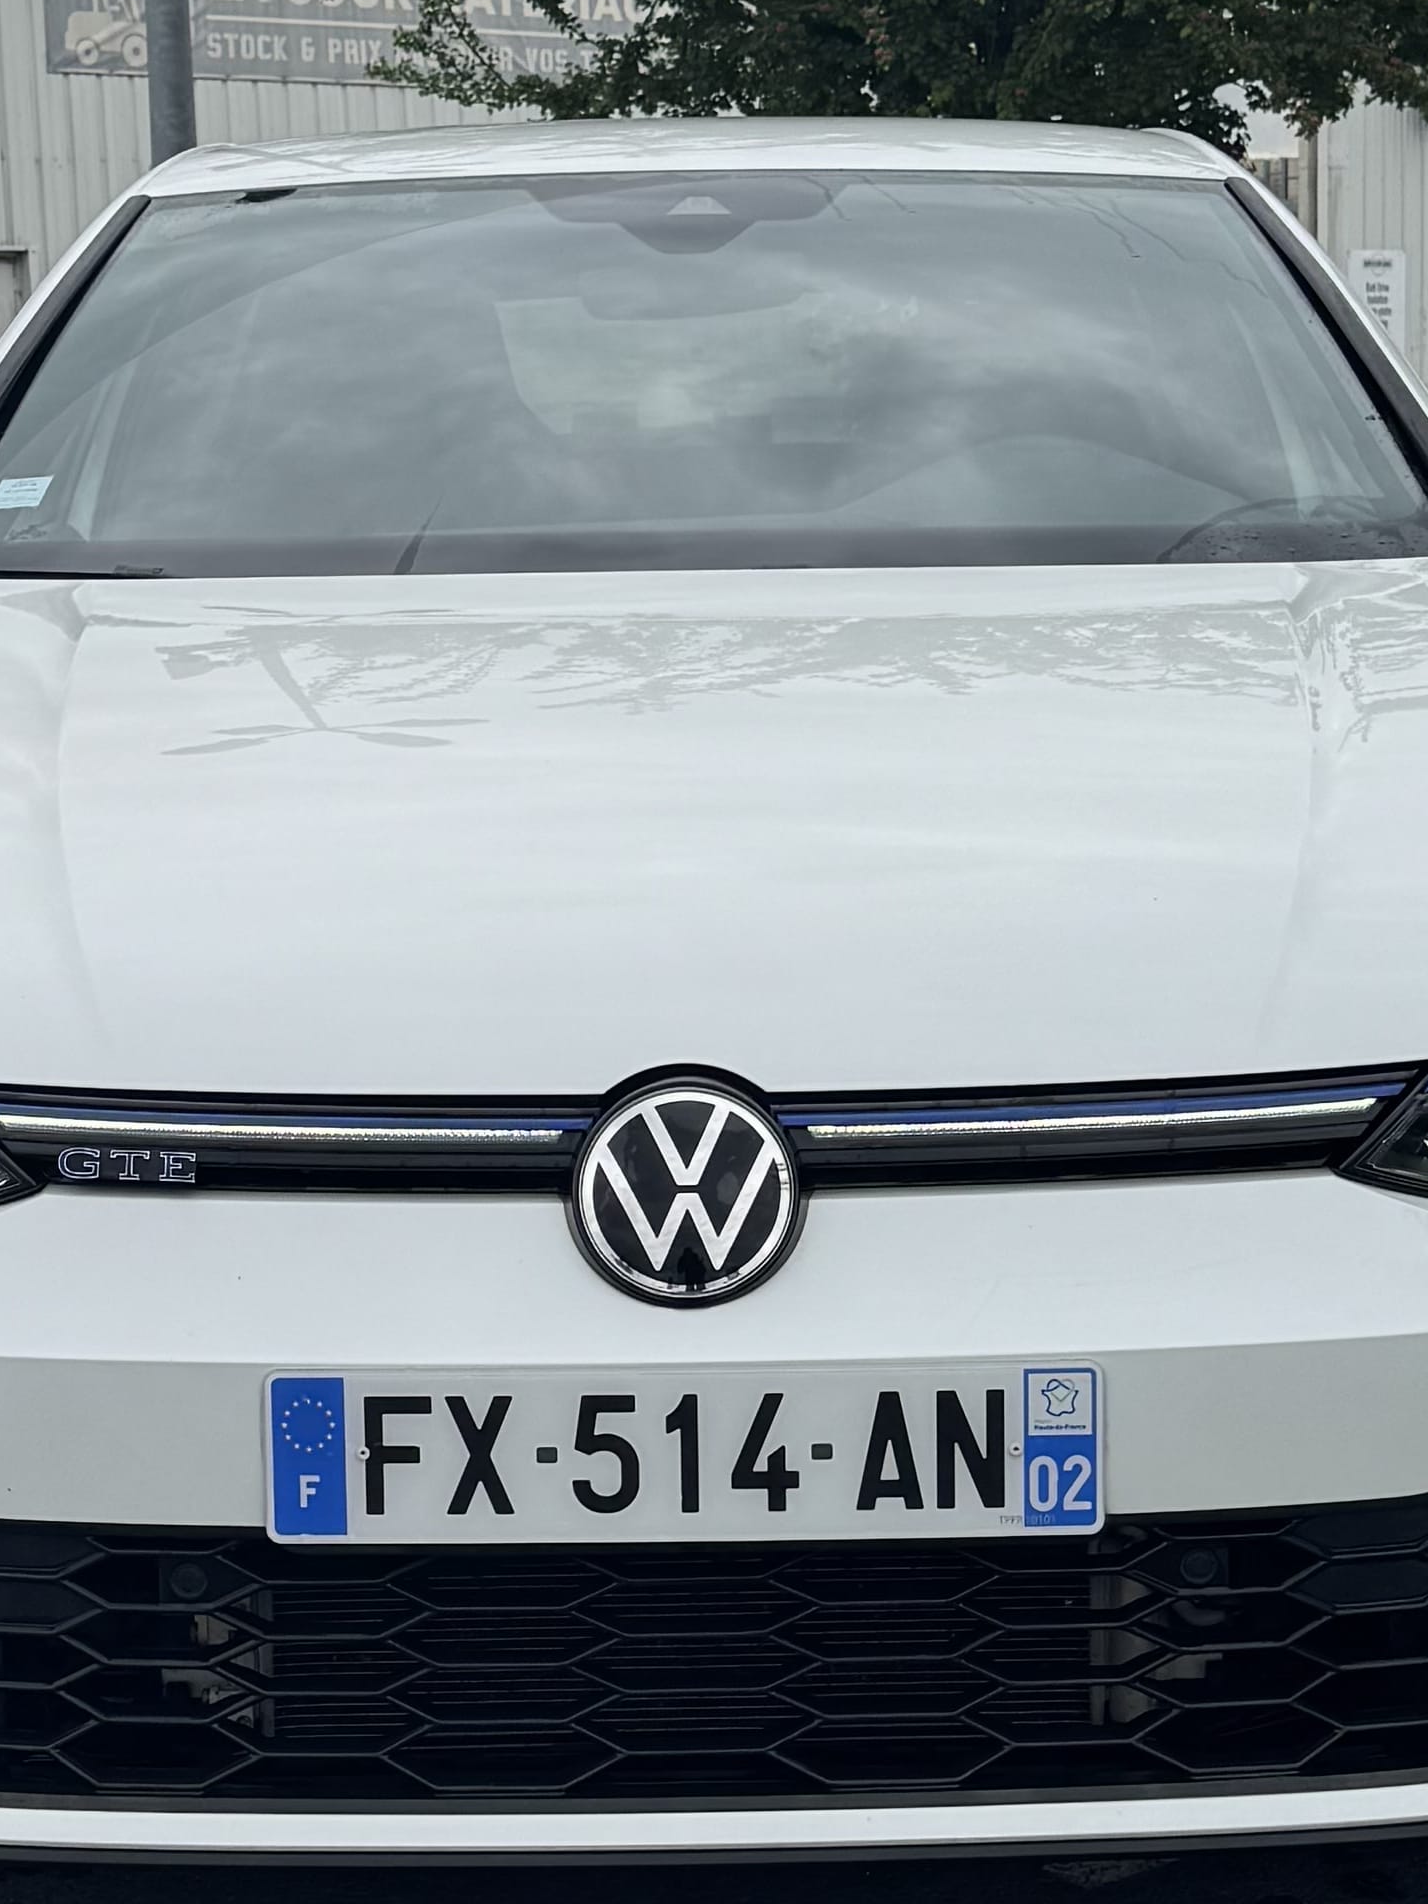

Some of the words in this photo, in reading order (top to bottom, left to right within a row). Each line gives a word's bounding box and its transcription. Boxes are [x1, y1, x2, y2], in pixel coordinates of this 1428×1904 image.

[206, 32, 288, 62] STOCK
[327, 37, 382, 65] PRIX
[58, 1147, 197, 1183] GTE
[299, 1474, 322, 1509] F
[363, 1388, 1006, 1516] FX-514-AN
[1029, 1454, 1093, 1512] 02
